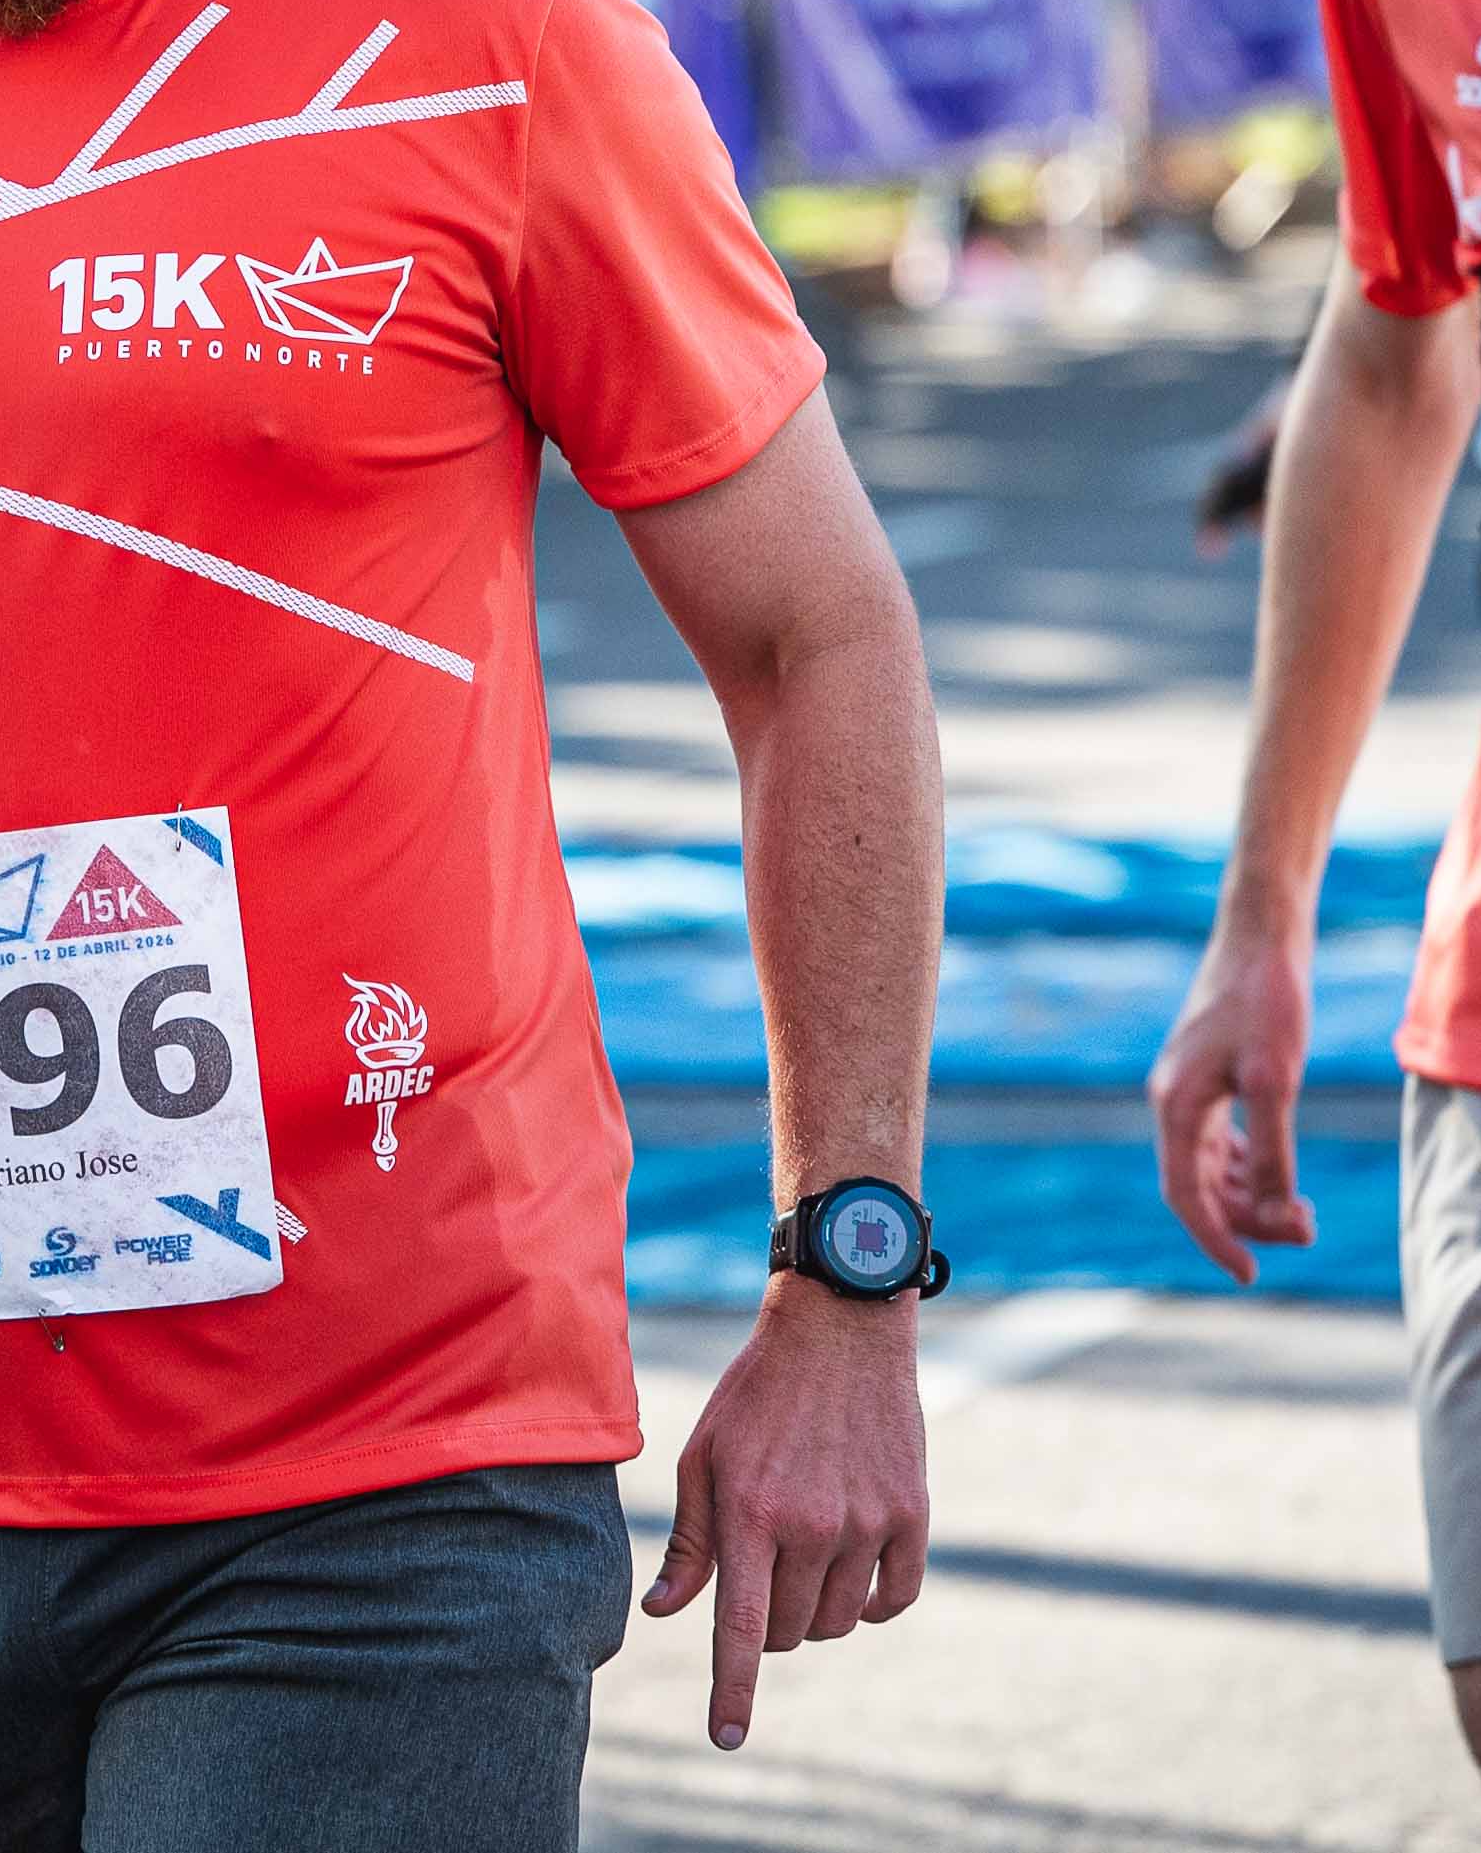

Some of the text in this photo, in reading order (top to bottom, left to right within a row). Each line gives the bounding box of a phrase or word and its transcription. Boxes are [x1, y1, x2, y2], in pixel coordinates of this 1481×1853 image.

[48, 252, 228, 335] 15K
[58, 338, 376, 375] PUERTO NORTE
[76, 885, 148, 925] 15K
[34, 948, 51, 963] 12
[57, 945, 78, 959] DE
[83, 940, 131, 956] ABRIL
[136, 935, 174, 951] 2026
[344, 1065, 435, 1107] ARDEC
[75, 1151, 139, 1180] Jose
[115, 1233, 193, 1255] POWER
